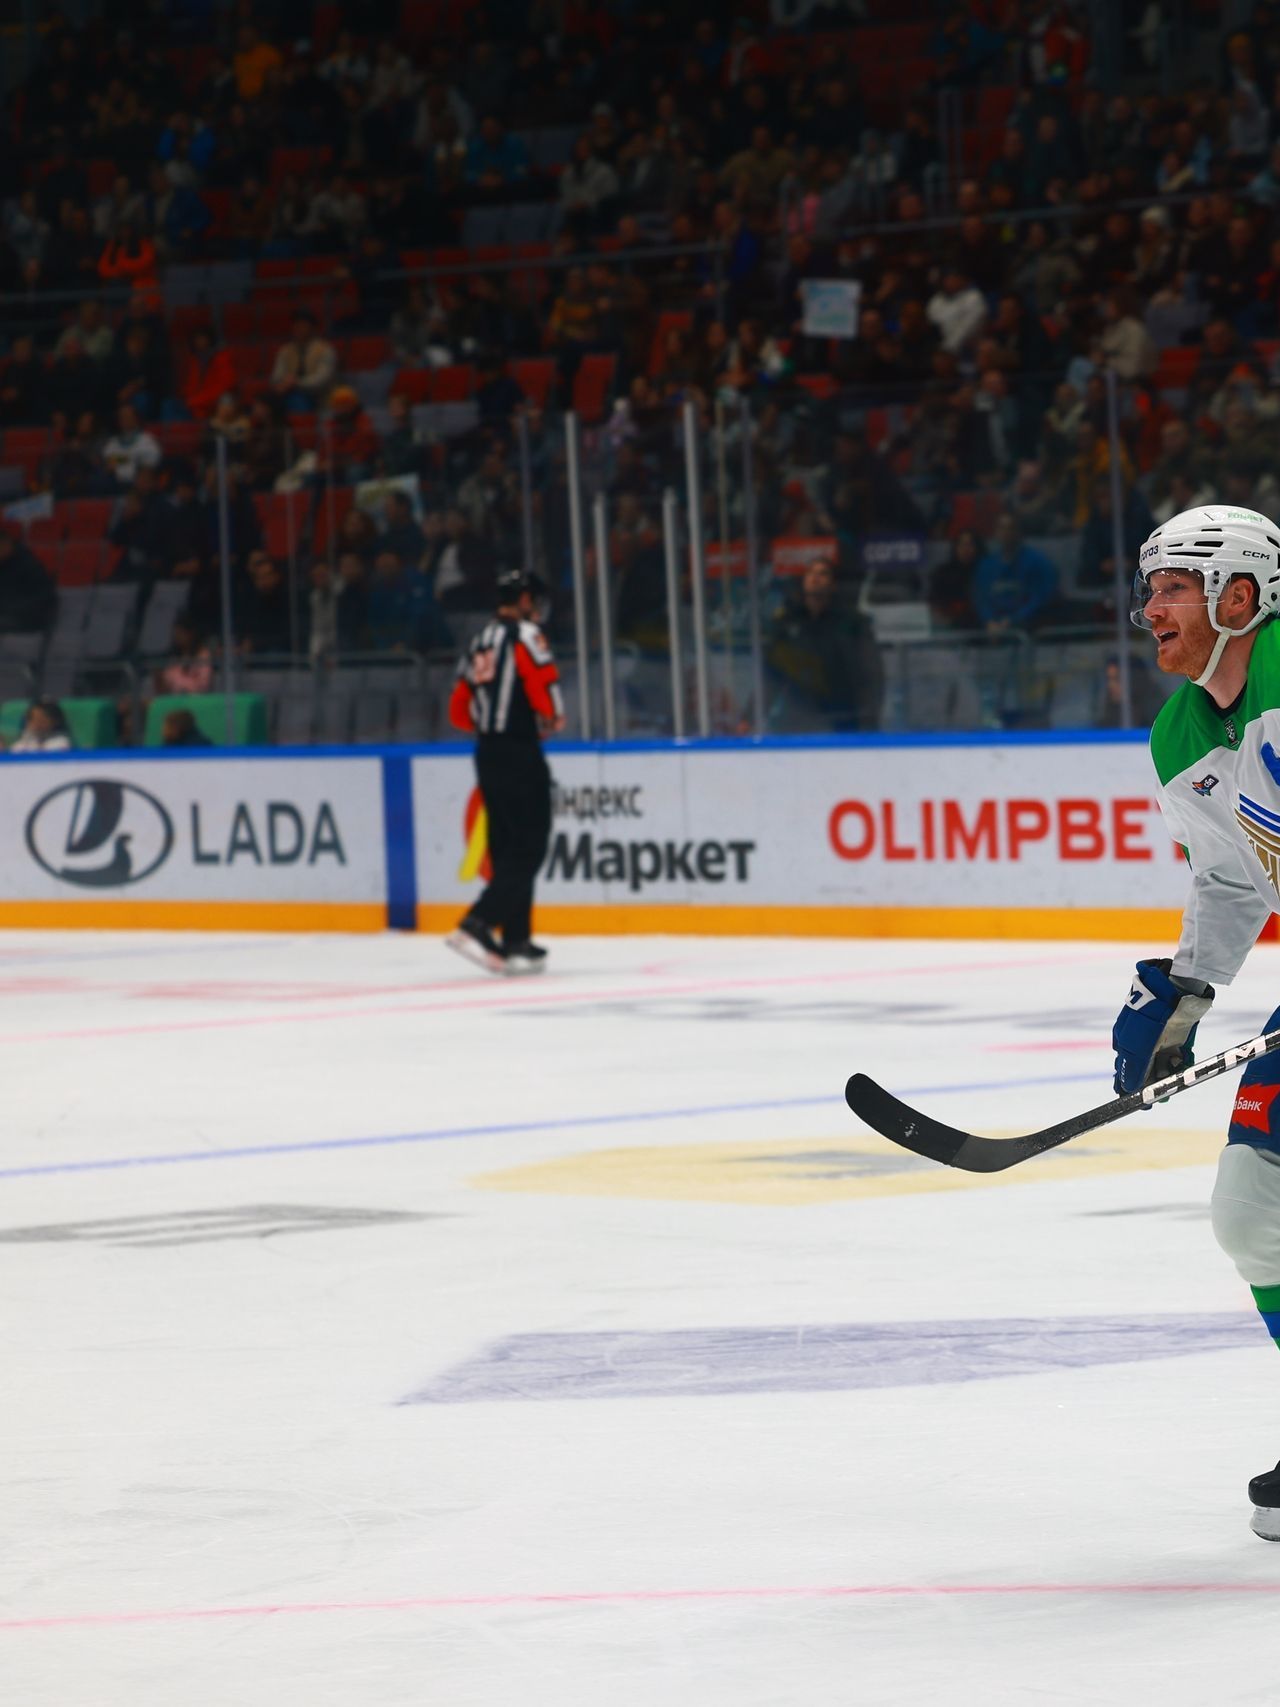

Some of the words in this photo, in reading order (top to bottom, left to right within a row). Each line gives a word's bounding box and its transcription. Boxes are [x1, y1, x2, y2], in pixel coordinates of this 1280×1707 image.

[1243, 550, 1270, 560] CCM
[191, 802, 346, 866] LADA
[547, 831, 756, 891] Маркет
[1238, 1096, 1263, 1112] Банк
